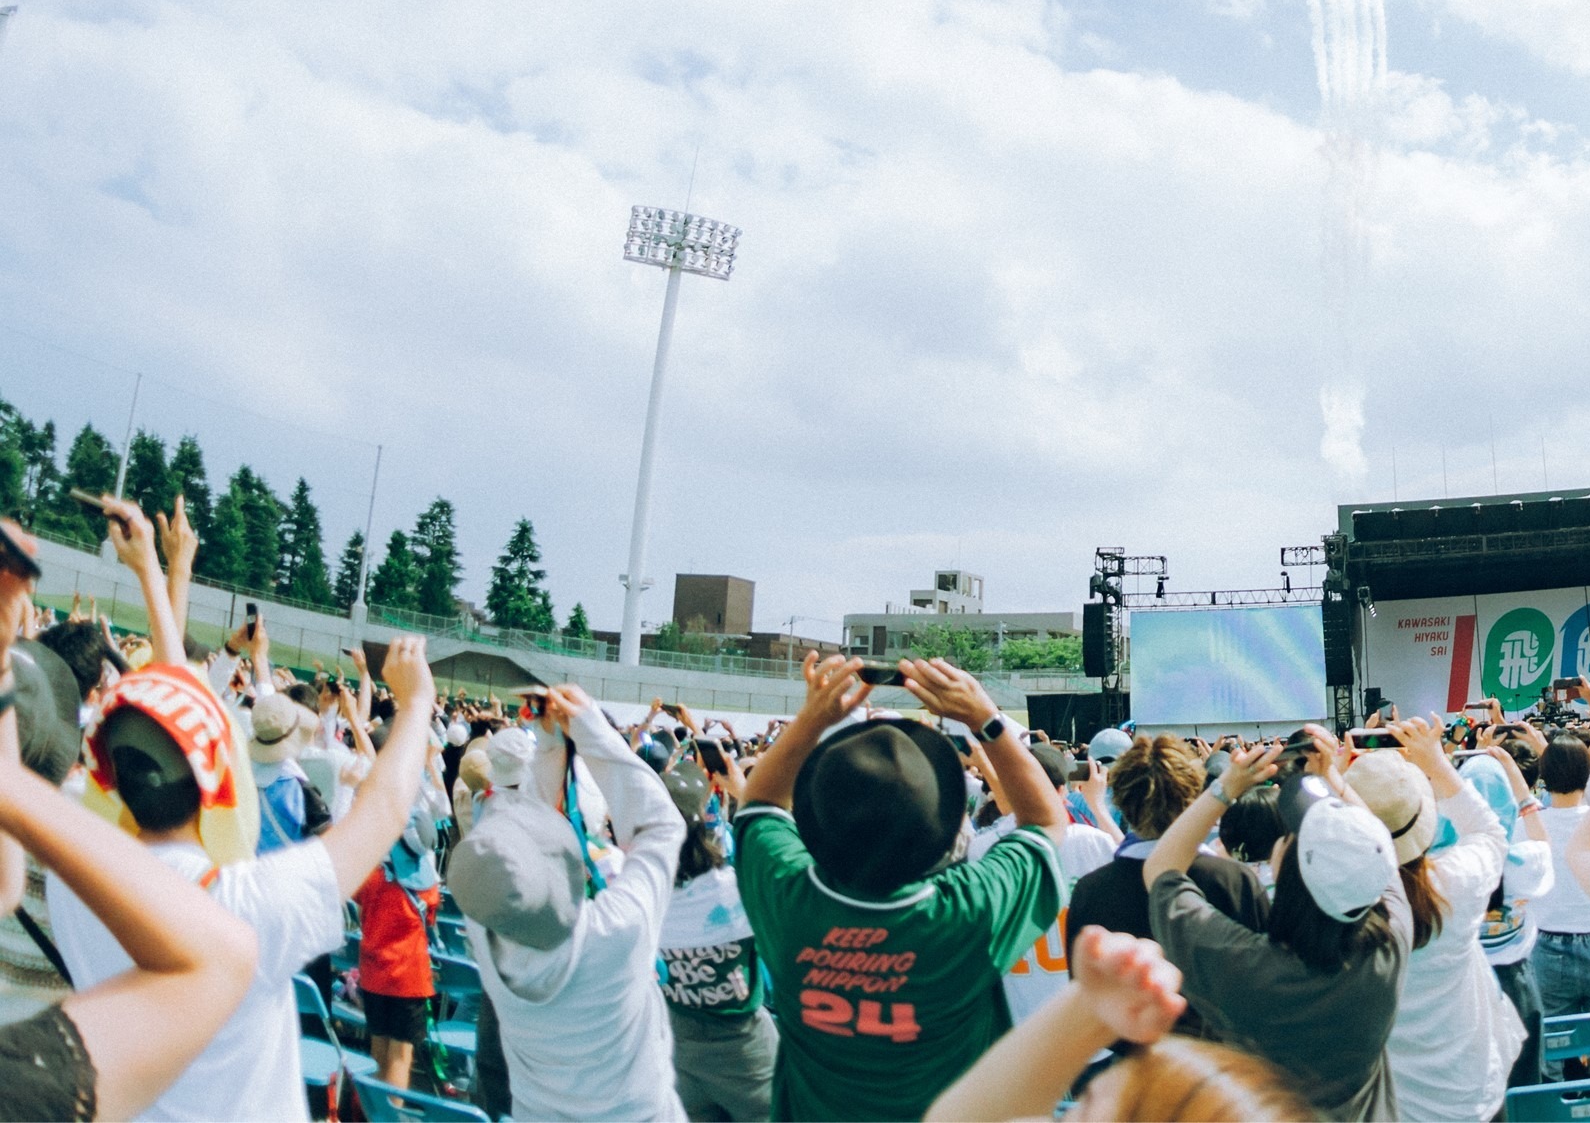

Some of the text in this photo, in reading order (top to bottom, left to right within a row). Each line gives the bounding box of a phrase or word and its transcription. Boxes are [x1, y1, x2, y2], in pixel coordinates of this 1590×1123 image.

[1397, 616, 1451, 629] KAWASAKI
[1414, 631, 1449, 643] HIYAKU
[1430, 645, 1448, 656] SAI
[822, 926, 888, 948] KEEP
[796, 946, 916, 973] POURING
[669, 960, 717, 985] Be
[802, 968, 908, 993] NIPPON
[800, 988, 922, 1043] 24
